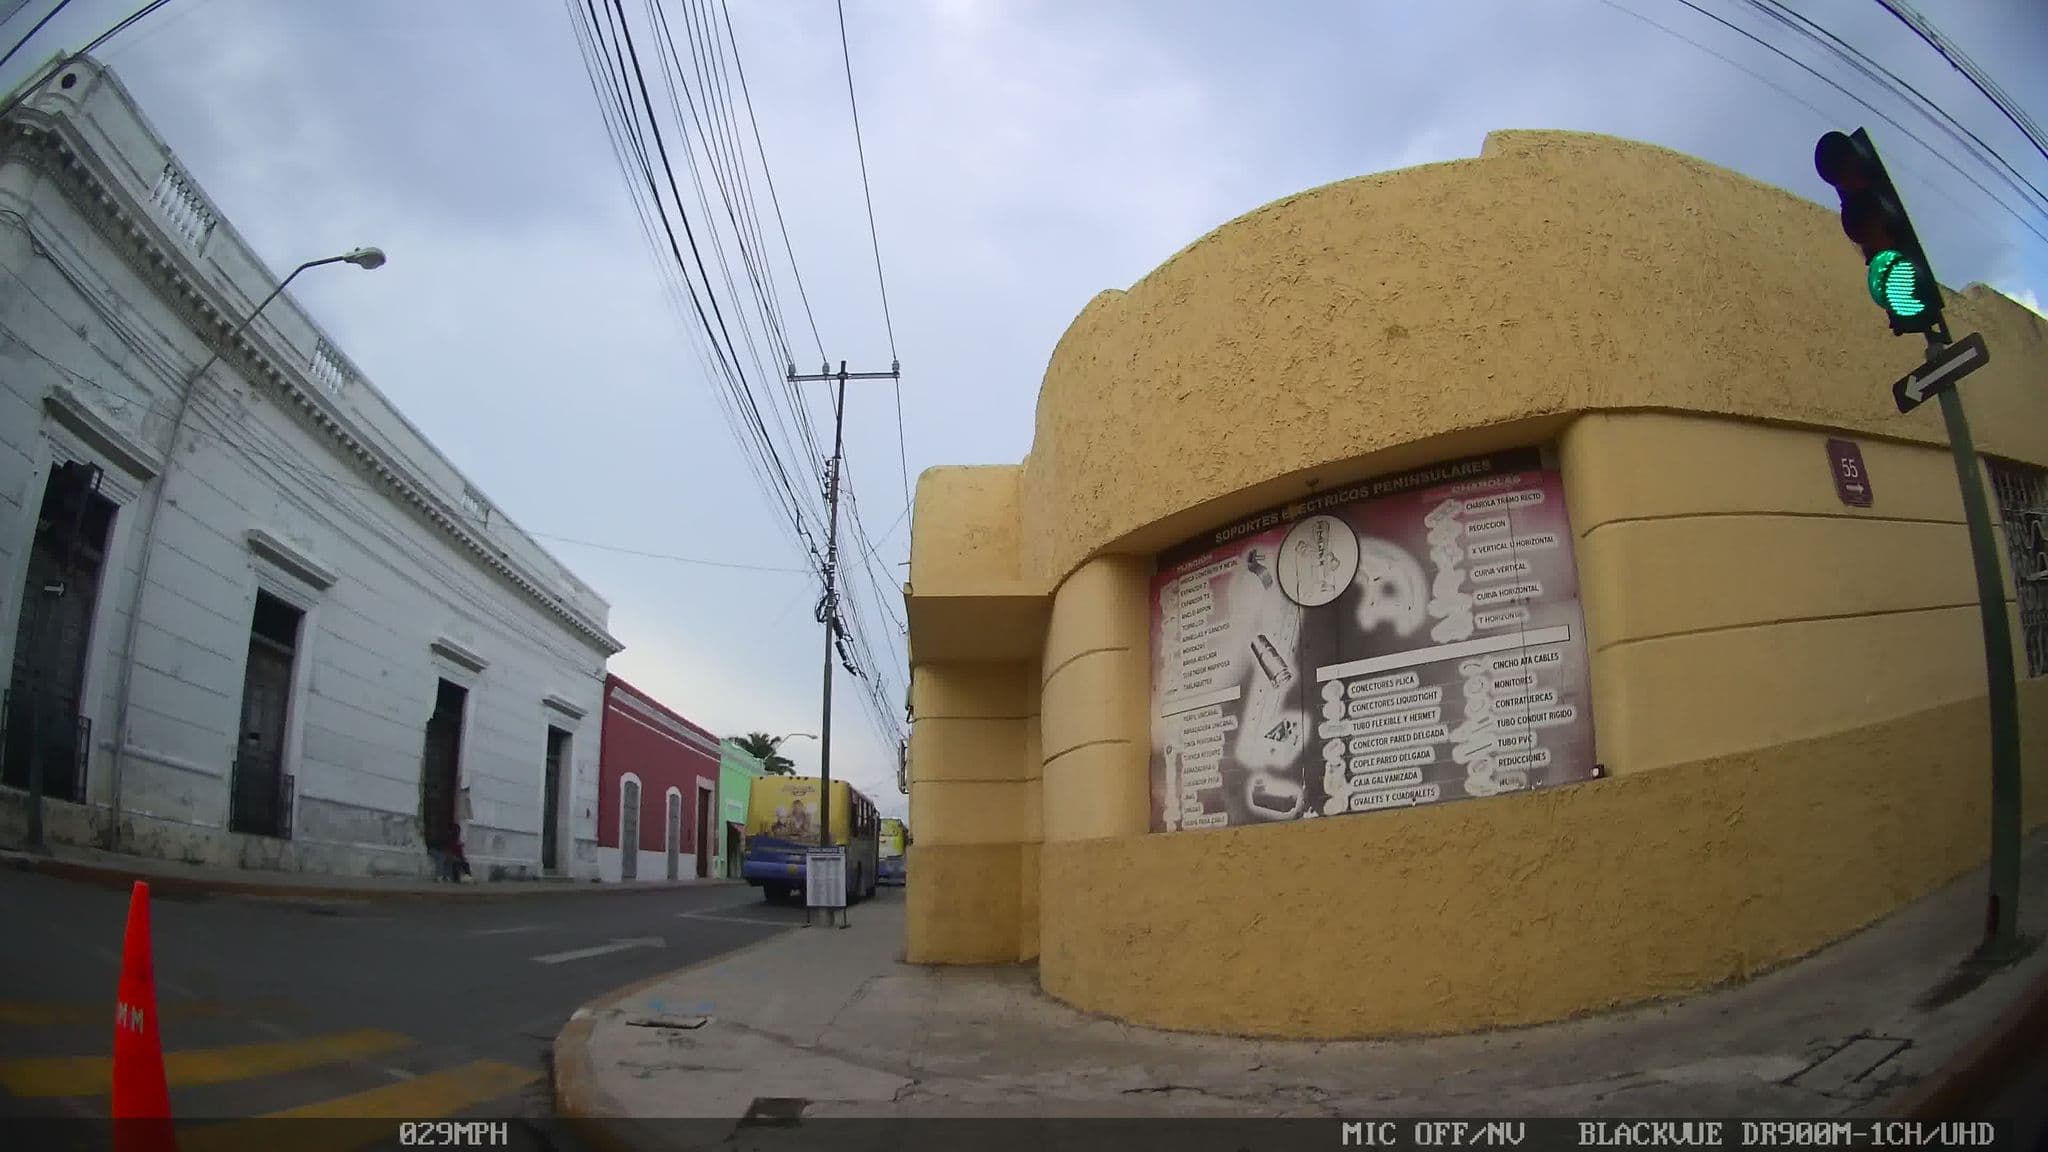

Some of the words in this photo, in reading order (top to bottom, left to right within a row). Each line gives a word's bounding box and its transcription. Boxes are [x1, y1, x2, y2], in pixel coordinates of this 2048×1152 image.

[1841, 458, 1858, 477] 55
[1215, 512, 1279, 544] SOPORTES
[1281, 486, 1369, 521] EECTRICOS
[1373, 460, 1492, 494] PENINSULARES
[1466, 499, 1496, 510] CHAROLA
[1521, 493, 1541, 501] RECTO
[1468, 521, 1506, 532] REDUCCION
[1478, 543, 1507, 553] VERTICAL
[1516, 536, 1554, 548] HORIZONTAL
[1474, 569, 1496, 577] CURVA
[1497, 564, 1527, 573] VERTICAL
[1477, 592, 1498, 601] CURVA
[1499, 585, 1539, 596] HORIZONTAL
[1493, 658, 1519, 670] CINCHO
[1534, 653, 1559, 663] CABLES
[1351, 680, 1394, 694] CONECTORES
[1494, 676, 1533, 688] MONITORES
[1352, 699, 1394, 712] CONECTORES
[1496, 693, 1553, 708] CONTRATUERCAS
[1353, 721, 1370, 731] TUBO
[1372, 716, 1401, 728] FLEXIBLE
[1404, 715, 1407, 723] Y
[1410, 711, 1436, 722] HERMET
[1497, 717, 1515, 727] TUBO
[1517, 714, 1547, 724] CONDUIT
[1549, 710, 1572, 720] RIGIDO
[1353, 737, 1388, 750] CONECTOR
[1390, 734, 1412, 743] PARED
[1413, 729, 1445, 740] DELGADA
[1498, 738, 1516, 747] TUBO
[1518, 735, 1532, 744] PVC
[1353, 758, 1375, 768] COPLE
[1376, 754, 1397, 765] PARED
[1399, 750, 1431, 762] DELGADA
[1498, 752, 1546, 766] REDUCCIONES
[1353, 777, 1370, 787] CAJA
[1372, 772, 1418, 785] GALVANIZADA
